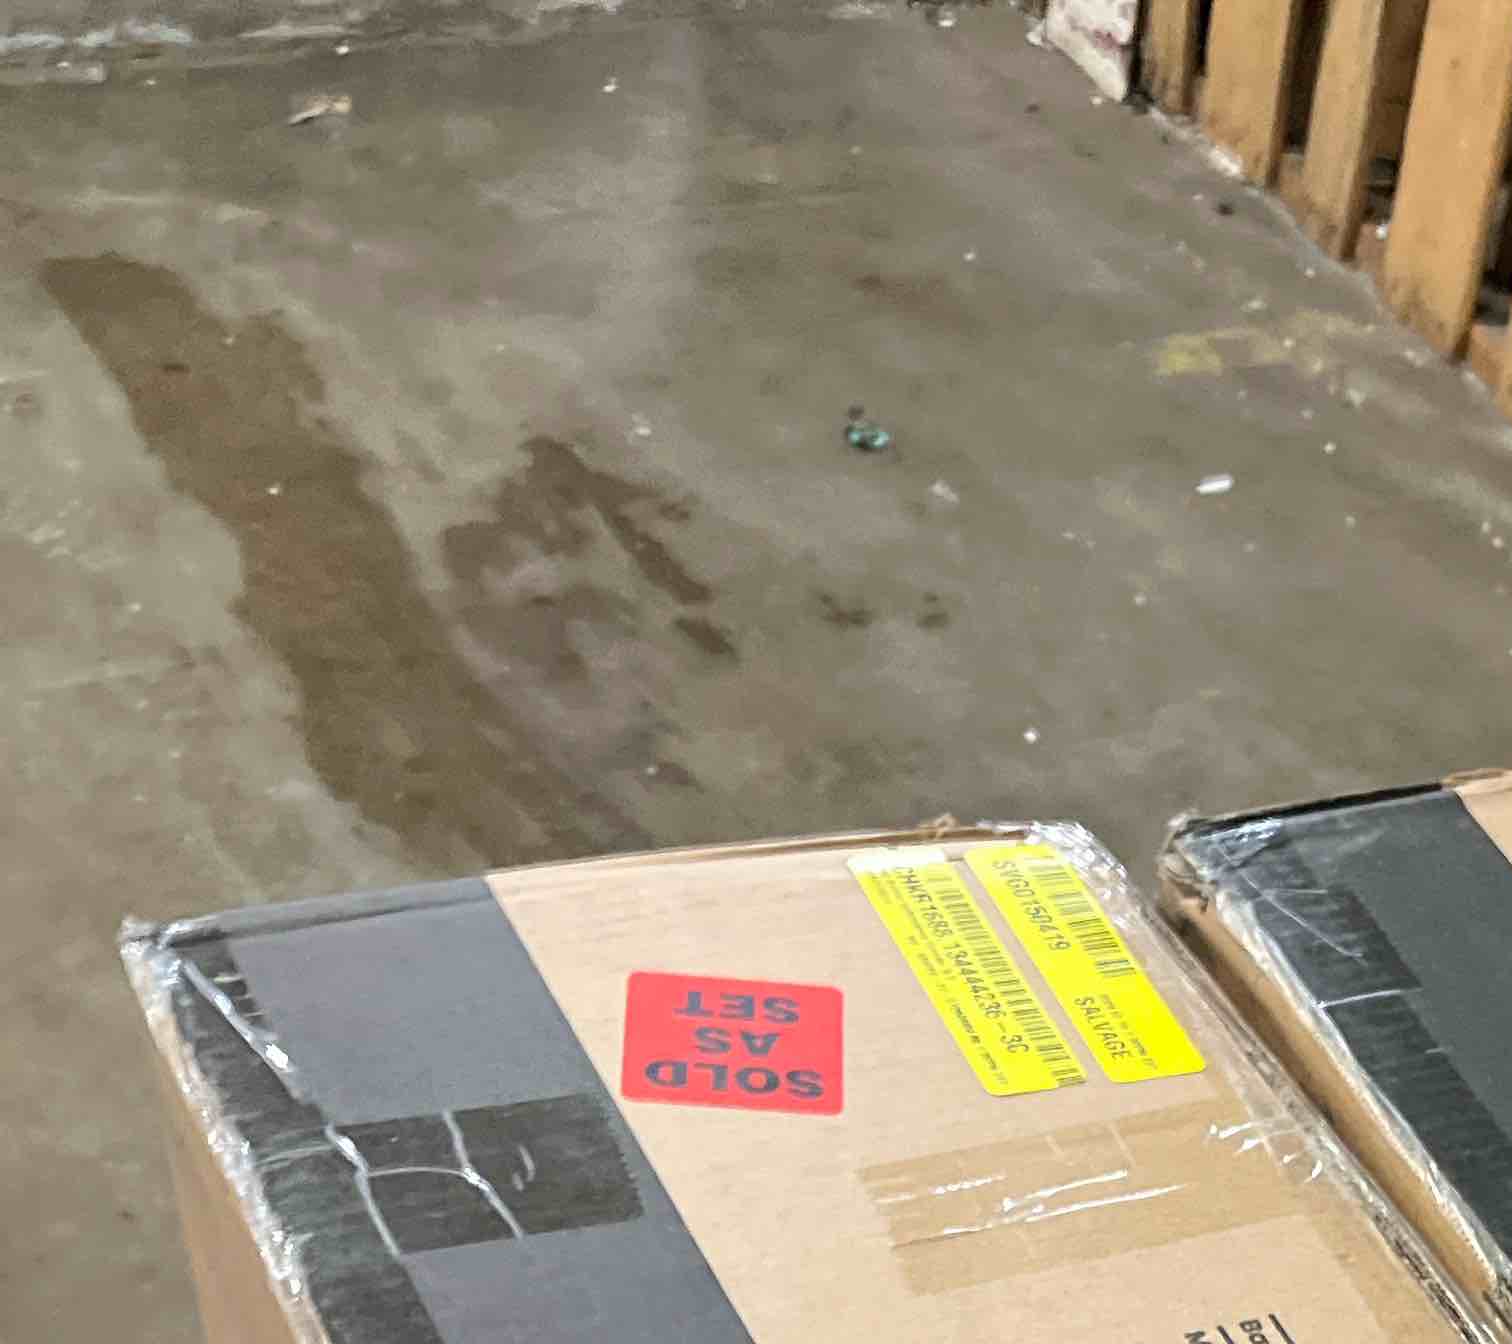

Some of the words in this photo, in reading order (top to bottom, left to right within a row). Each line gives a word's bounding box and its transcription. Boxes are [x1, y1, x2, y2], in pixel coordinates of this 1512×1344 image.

[673, 990, 800, 1023] SET
[693, 1027, 781, 1058] AS
[1074, 996, 1132, 1060] SALVAGE
[645, 1057, 826, 1099] SOLD
